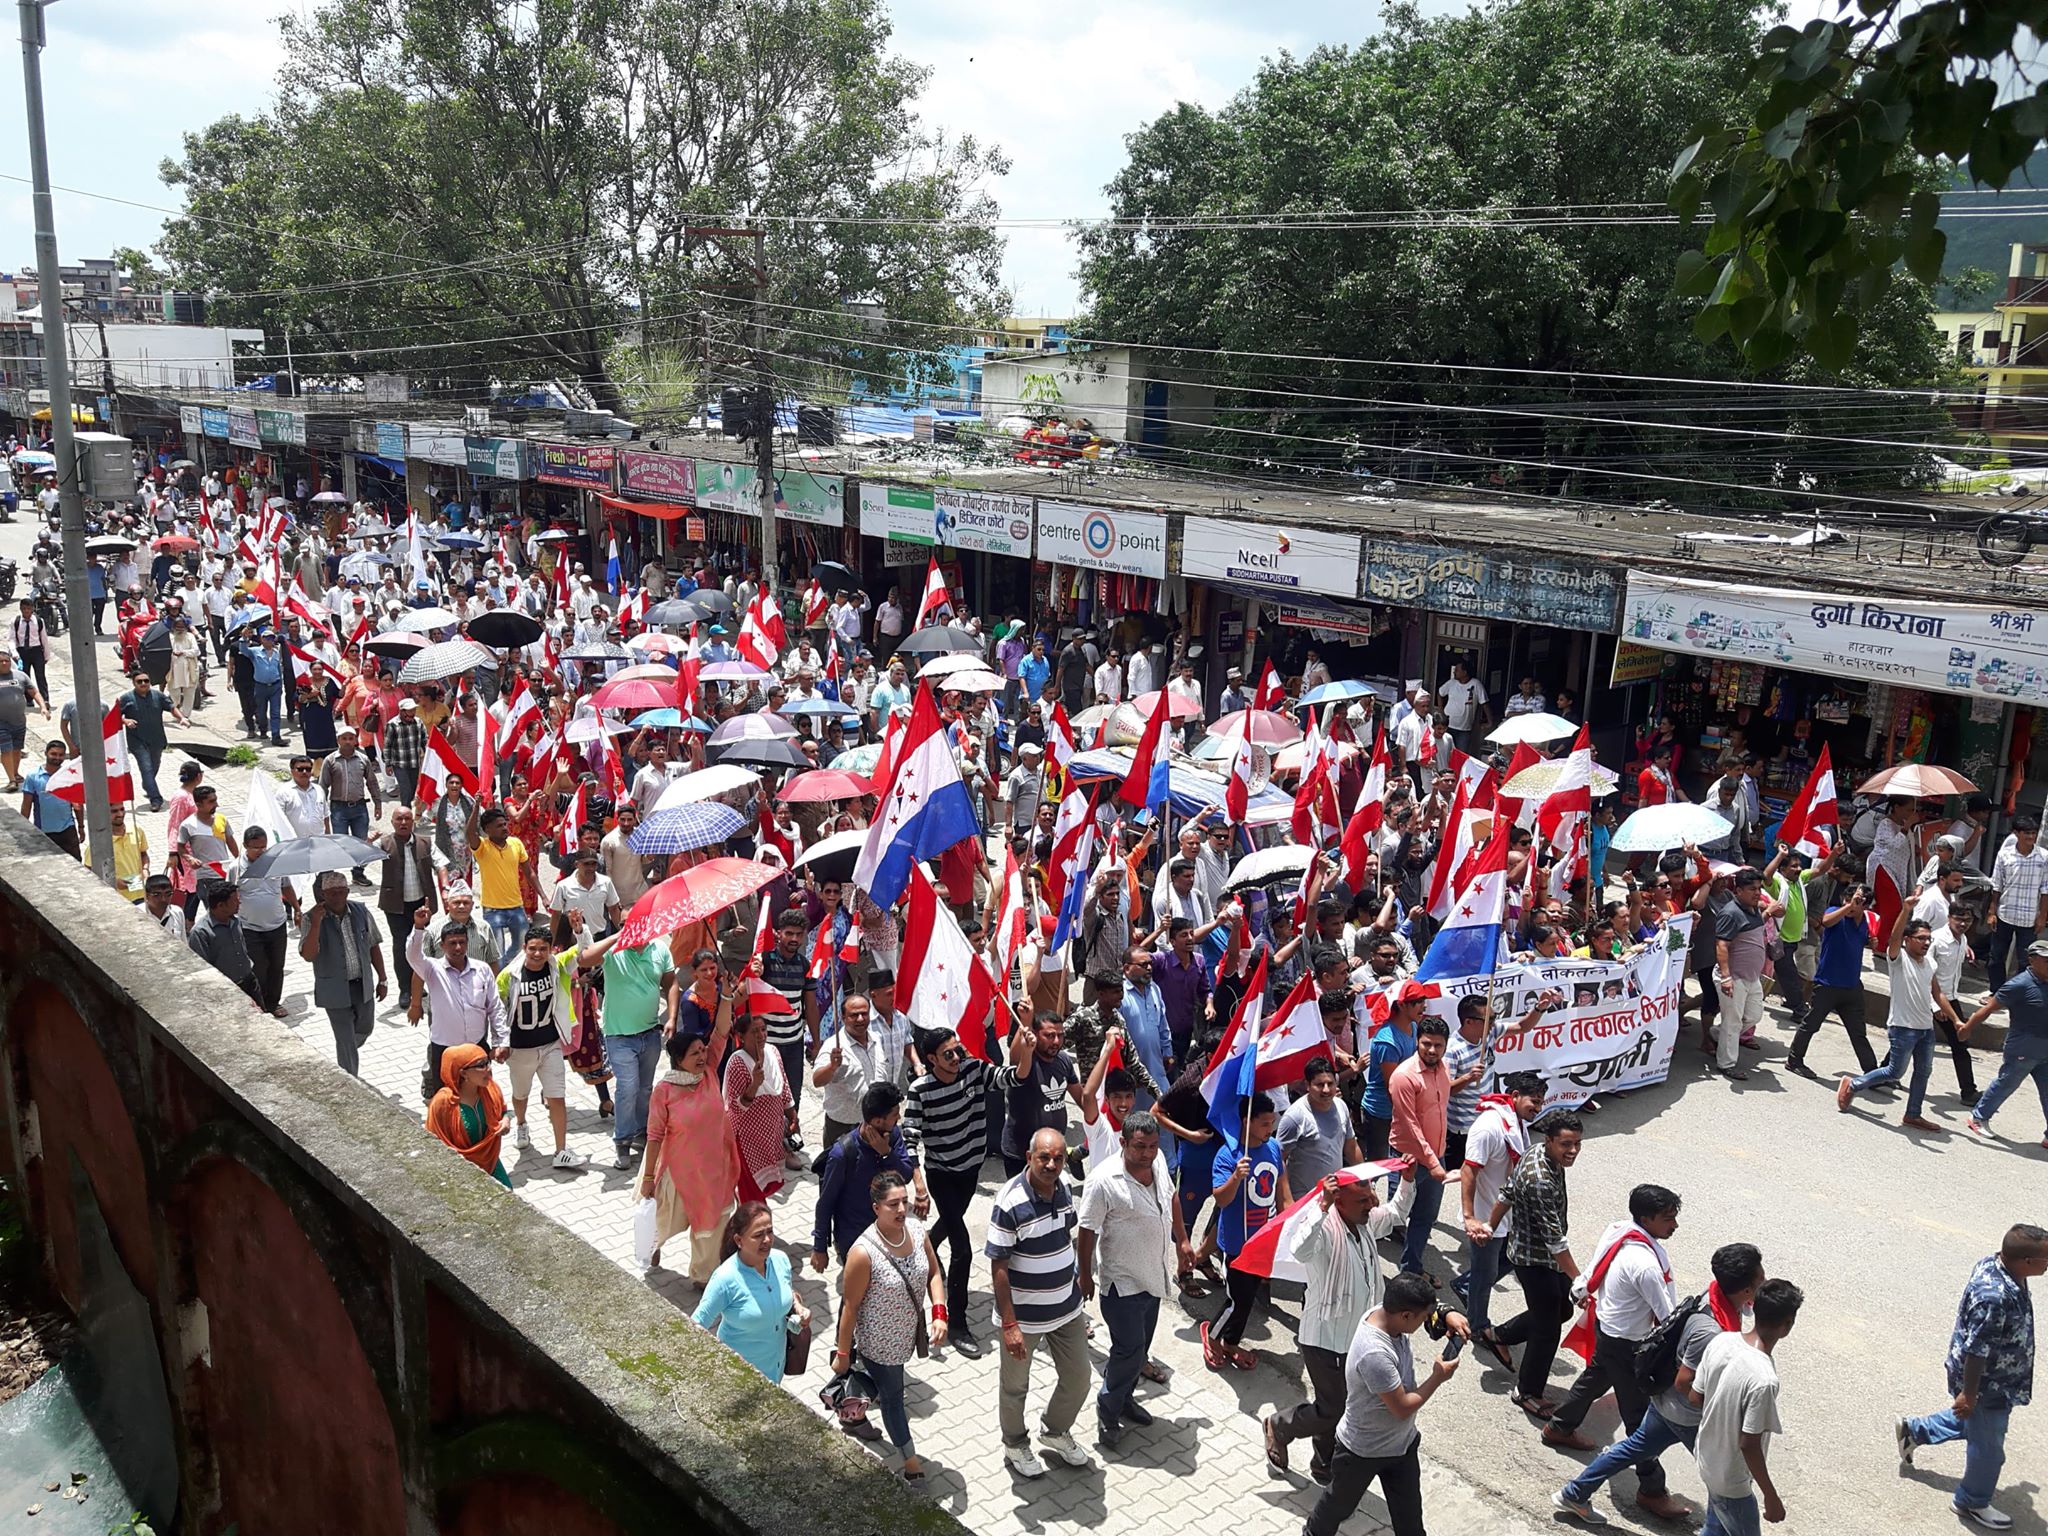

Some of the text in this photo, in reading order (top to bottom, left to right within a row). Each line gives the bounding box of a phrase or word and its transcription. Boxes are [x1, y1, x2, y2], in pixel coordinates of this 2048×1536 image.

[544, 447, 566, 465] Fresh
[1040, 523, 1081, 542] centre
[1120, 532, 1160, 552] point
[1057, 552, 1143, 574] ladies, gents & baby wears
[1238, 548, 1278, 569] Ncell
[1231, 569, 1294, 585] SIDDHARTHA PUSTAK
[1448, 580, 1476, 596] FAX
[1282, 609, 1297, 617] NTC
[1811, 602, 1947, 639] दुर्गा किराना
[517, 988, 554, 1031] 07
[1532, 1022, 1567, 1051] कर
[1569, 1009, 1639, 1044] तत्काल
[1043, 1098, 1066, 1113] adida
